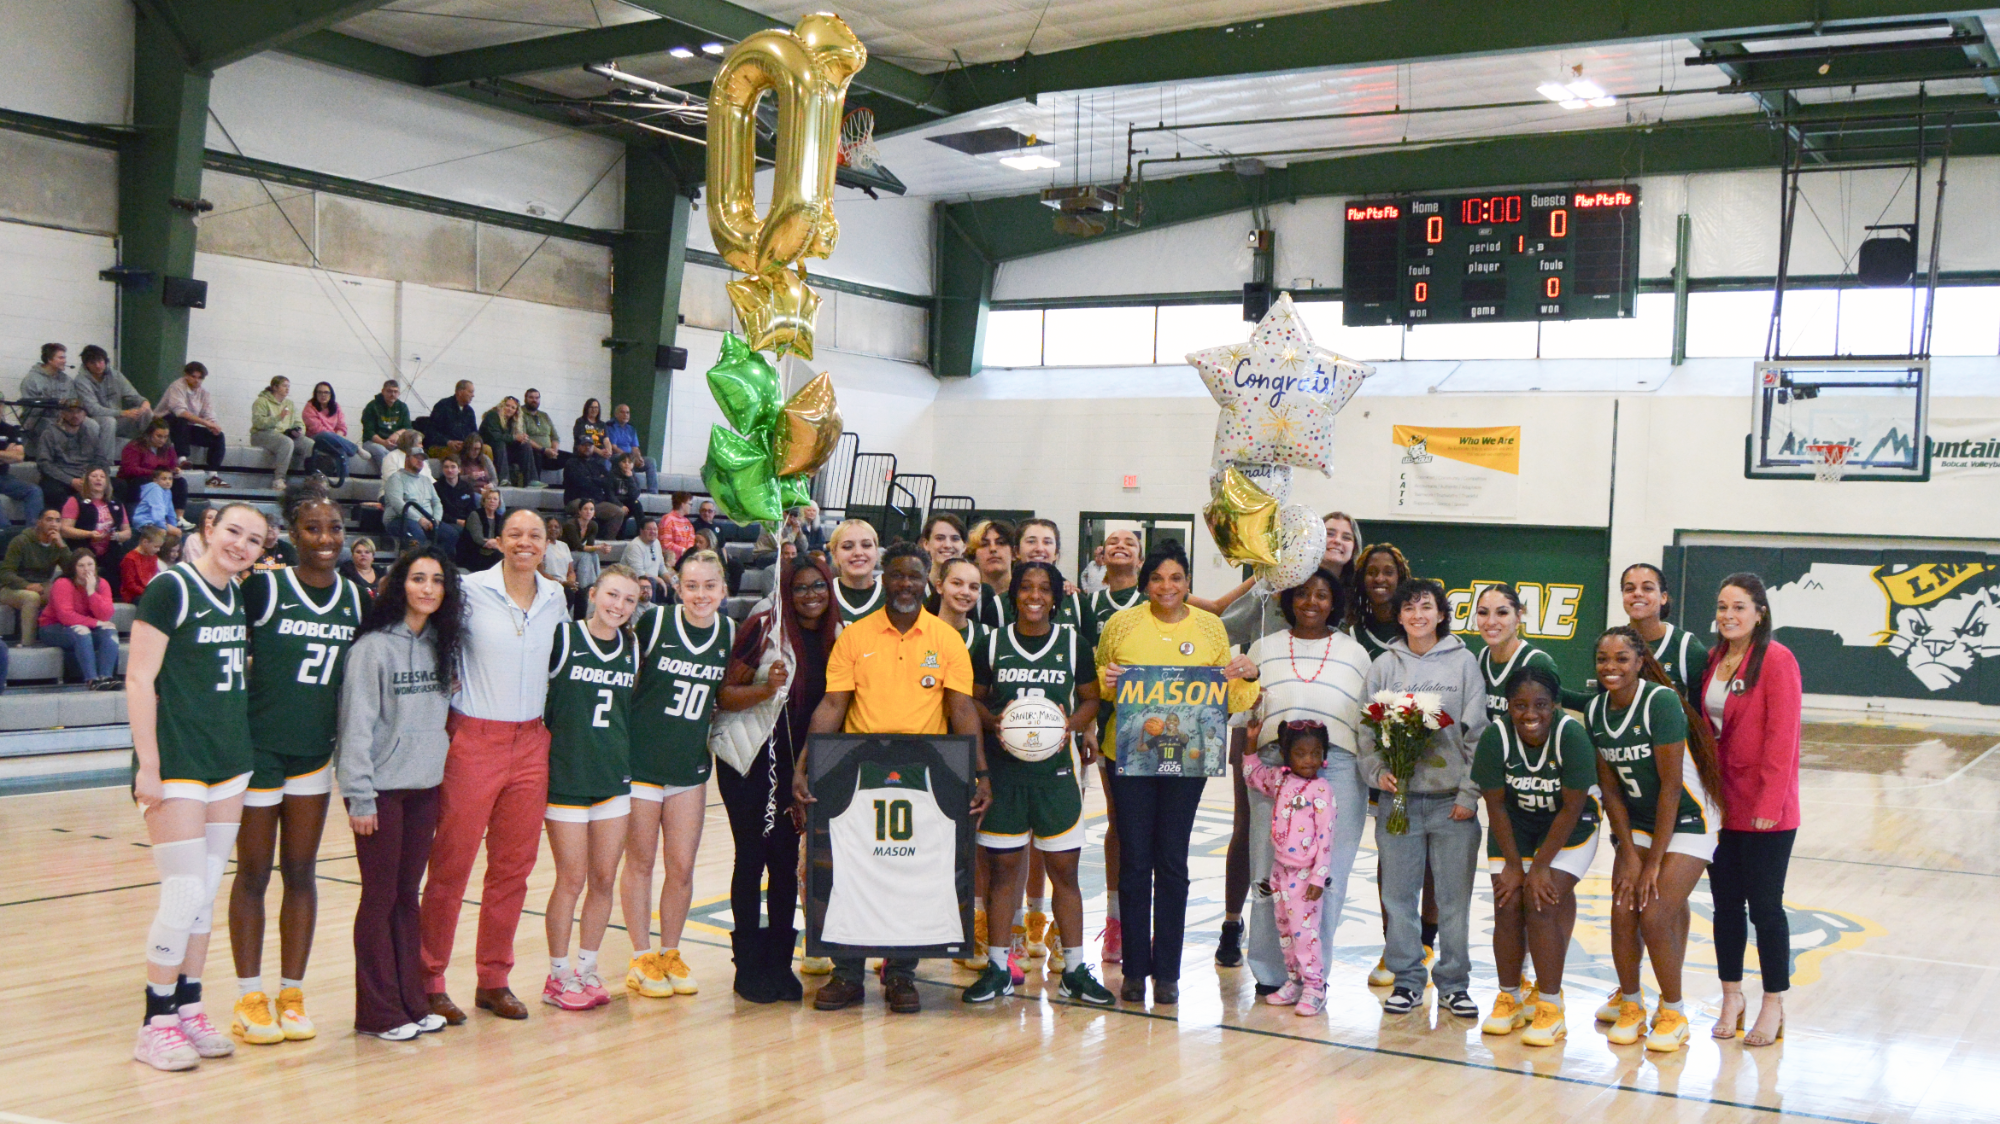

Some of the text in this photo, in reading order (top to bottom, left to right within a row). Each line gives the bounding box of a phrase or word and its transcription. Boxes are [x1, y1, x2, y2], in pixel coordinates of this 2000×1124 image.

[1412, 202, 1439, 214] Home
[1531, 194, 1566, 207] Guests
[1575, 191, 1632, 208] Plyr Pts Fls
[1347, 205, 1399, 221] Plyr Pts Fls
[1462, 195, 1521, 224] 10:00
[1427, 216, 1443, 243] 0
[1550, 209, 1567, 237] 0
[1469, 235, 1524, 255] period 1
[1408, 264, 1431, 276] fouls
[1468, 261, 1500, 274] player
[1539, 259, 1564, 271] fouls
[1415, 282, 1427, 302] 0
[1546, 276, 1560, 298] 0
[1409, 309, 1427, 318] won
[1471, 306, 1496, 318] game
[1541, 304, 1559, 314] won
[1459, 437, 1515, 445] Who We Are
[1123, 475, 1137, 487] EXIT
[278, 618, 356, 641] BOBCATS
[216, 647, 246, 691] 34
[297, 643, 340, 685] 21
[657, 656, 726, 680] BOBCATS
[569, 665, 635, 687] BOBCATS
[998, 668, 1067, 684] BOBCATS
[664, 680, 711, 720] 30
[1117, 680, 1228, 706] MASON
[592, 689, 613, 727] 2
[1163, 747, 1175, 759] 10
[1598, 743, 1652, 762] OBCATS
[1157, 764, 1181, 773] 2026
[1617, 766, 1642, 798] 5
[1518, 793, 1556, 812] 24
[873, 799, 913, 841] 10
[873, 847, 916, 857] MASON
